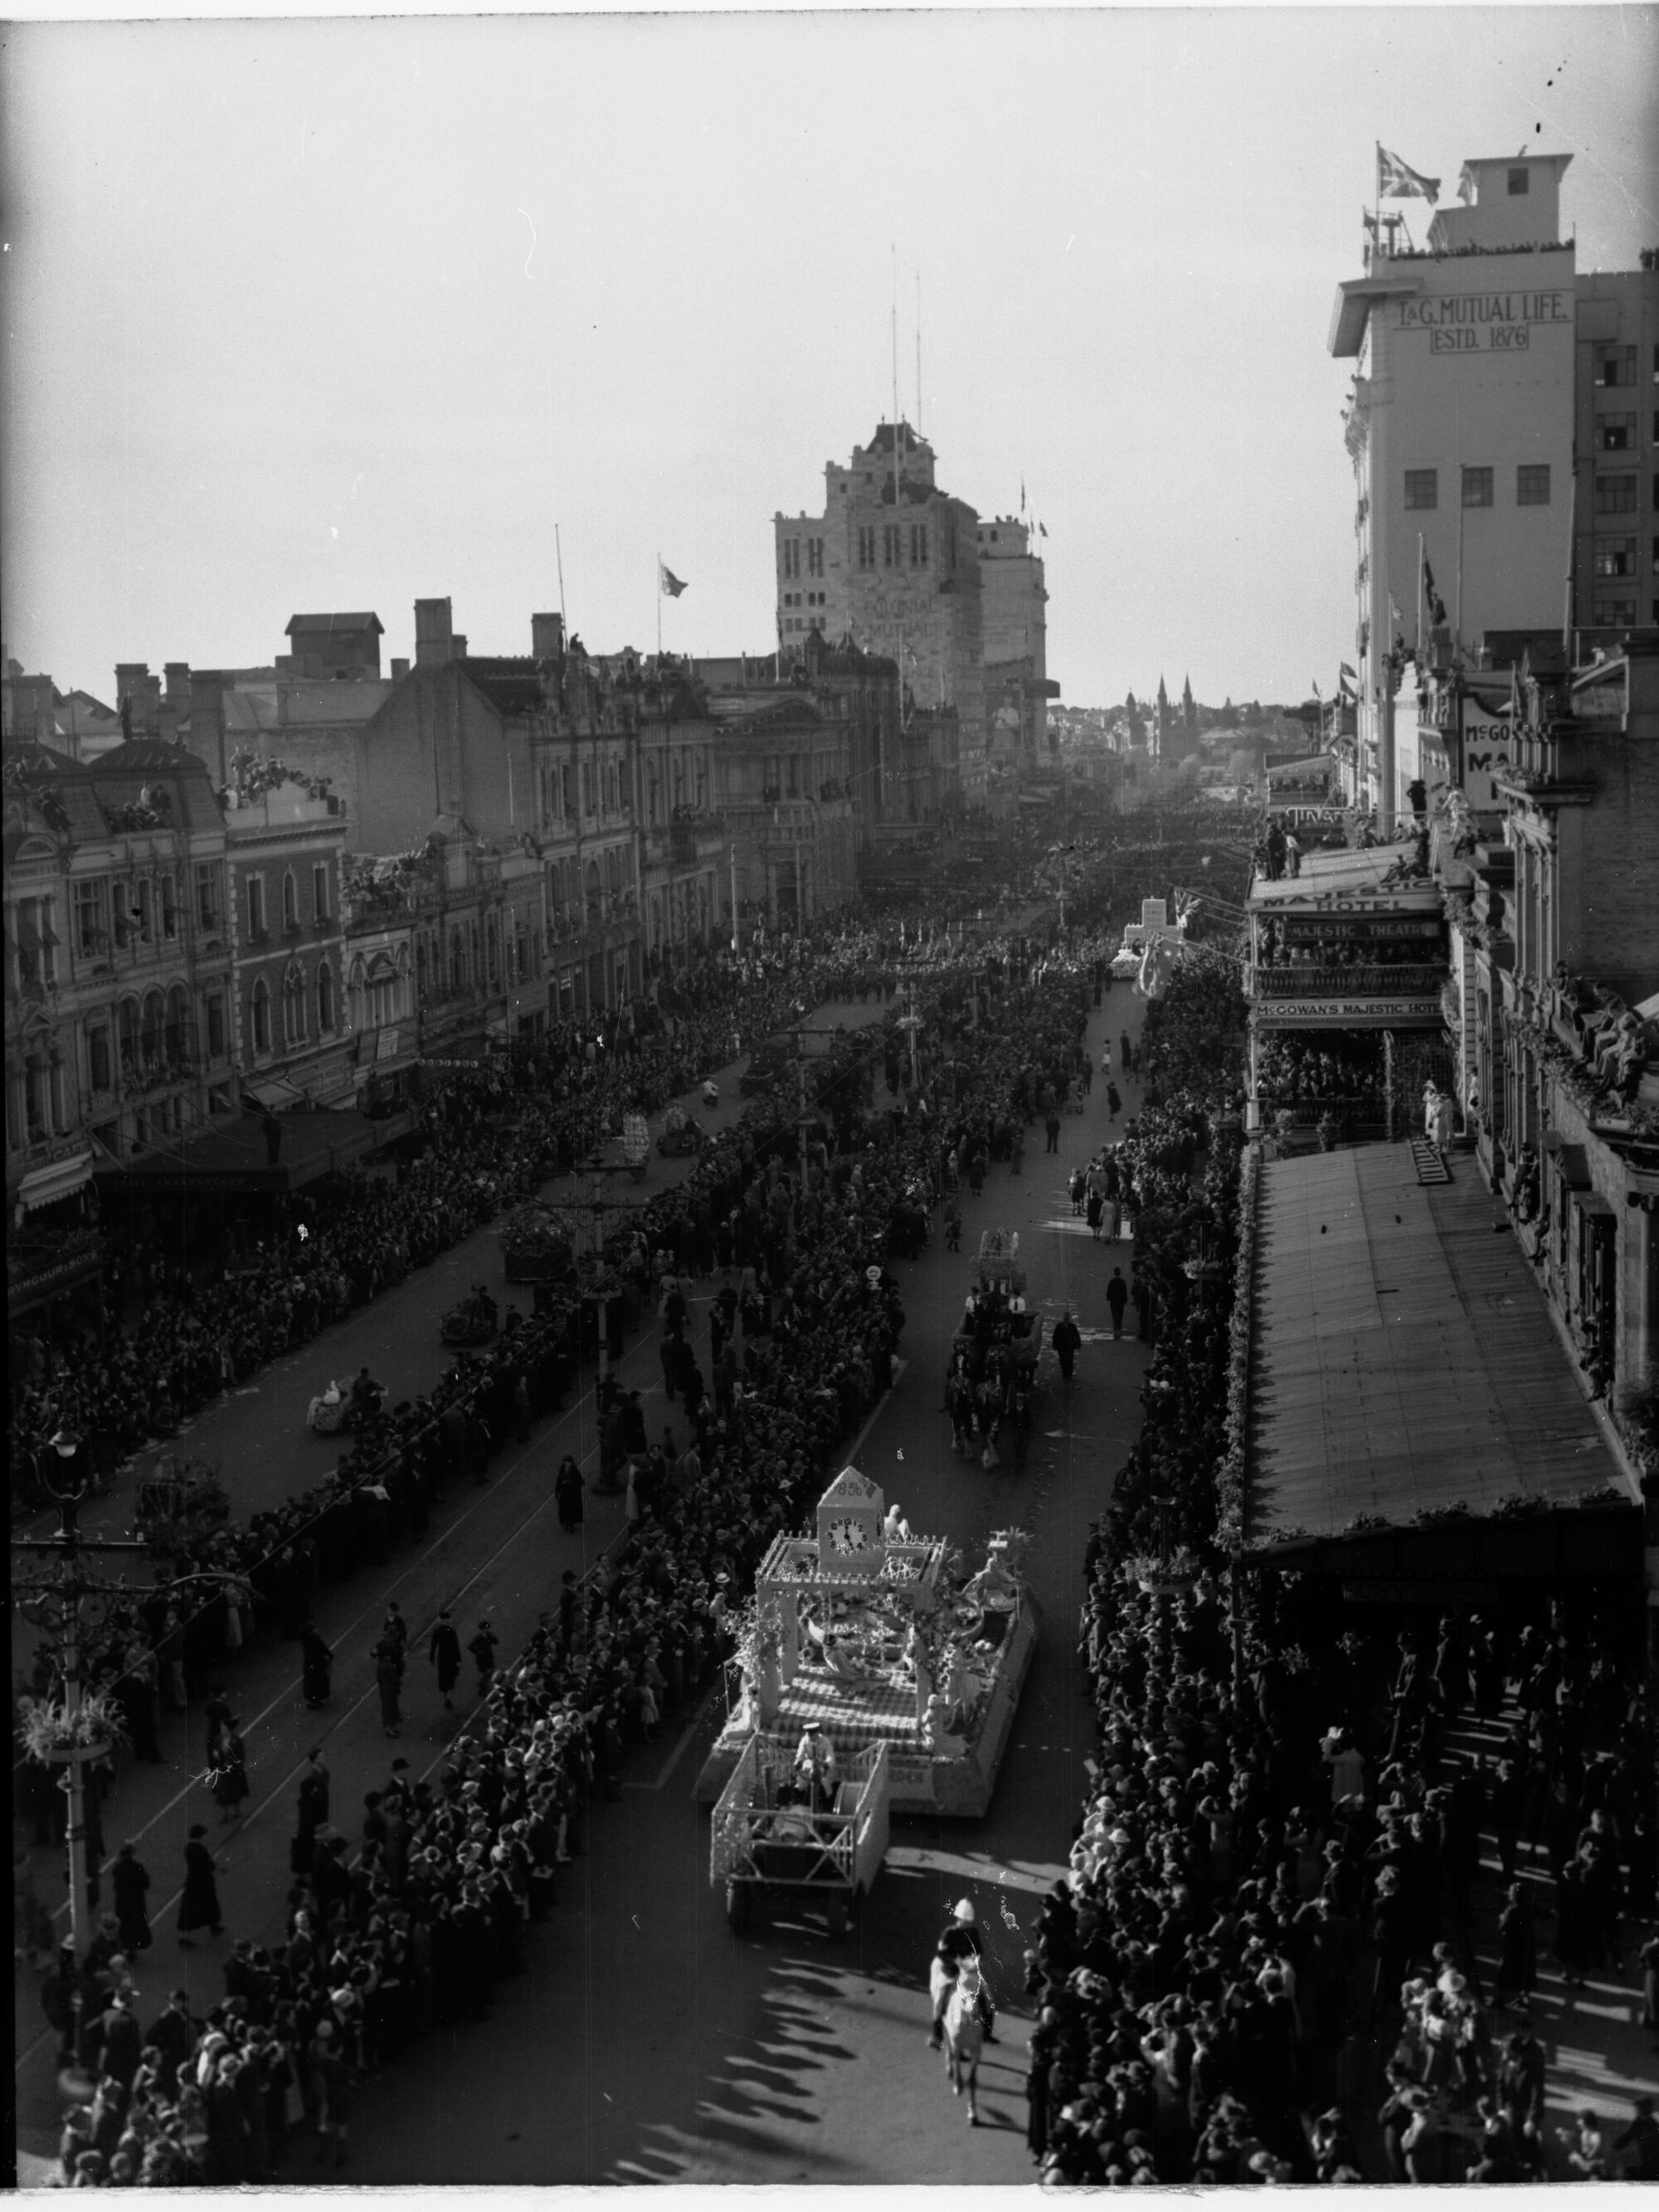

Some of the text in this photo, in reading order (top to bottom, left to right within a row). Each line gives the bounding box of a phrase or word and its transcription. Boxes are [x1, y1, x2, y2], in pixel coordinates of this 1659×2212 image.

[1440, 295, 1516, 324] MUTUAL
[1490, 325, 1526, 348] 1876
[864, 597, 934, 618] COLONIAL
[868, 623, 931, 638] MUTUAL
[1465, 725, 1510, 742] McGO
[1262, 879, 1433, 908] MAJESTIC
[1316, 899, 1408, 912] HOTEL
[1292, 924, 1356, 938] MAJESTIC
[1343, 1004, 1404, 1014] MAJESTIC
[1408, 1003, 1442, 1013] HOTE
[52, 1140, 88, 1162] CAFE
